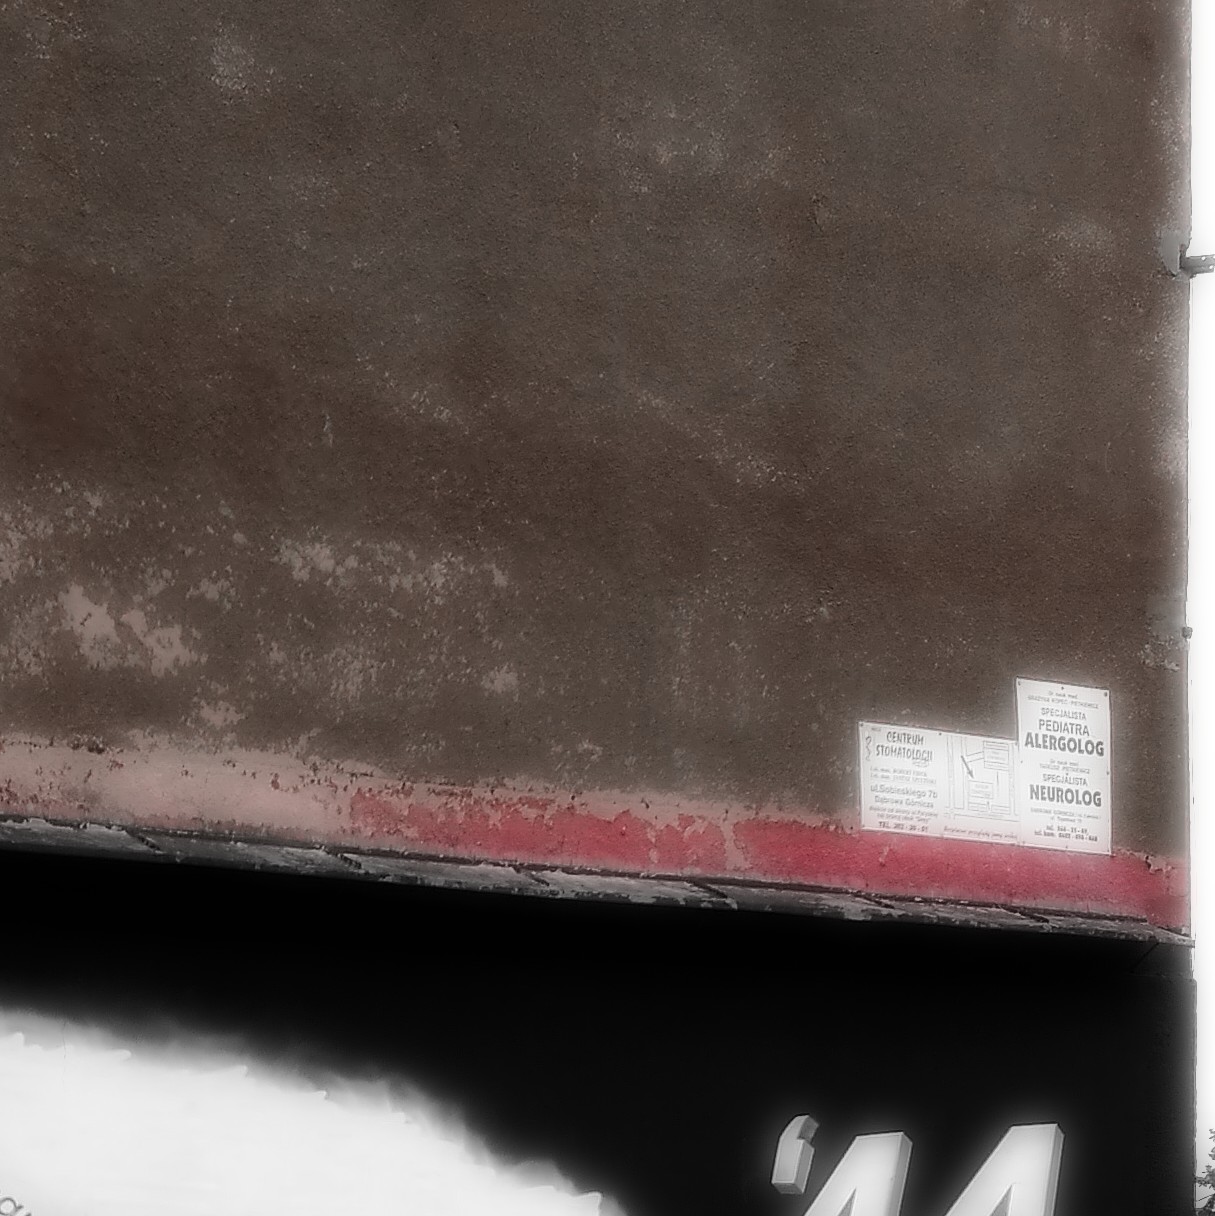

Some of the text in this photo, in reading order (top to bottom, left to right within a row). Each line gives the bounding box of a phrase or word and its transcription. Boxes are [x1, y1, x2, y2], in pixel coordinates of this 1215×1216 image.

[1040, 707, 1087, 721] SPECJALISTA
[1038, 718, 1090, 737] PEDIATRA
[886, 731, 925, 746] CENTRUM
[1024, 731, 1105, 757] ALERGOLOG
[875, 744, 933, 762] STOMATOLOGII
[1042, 773, 1088, 787] SPECJALISTA
[1029, 783, 1102, 808] NEUROLOG
